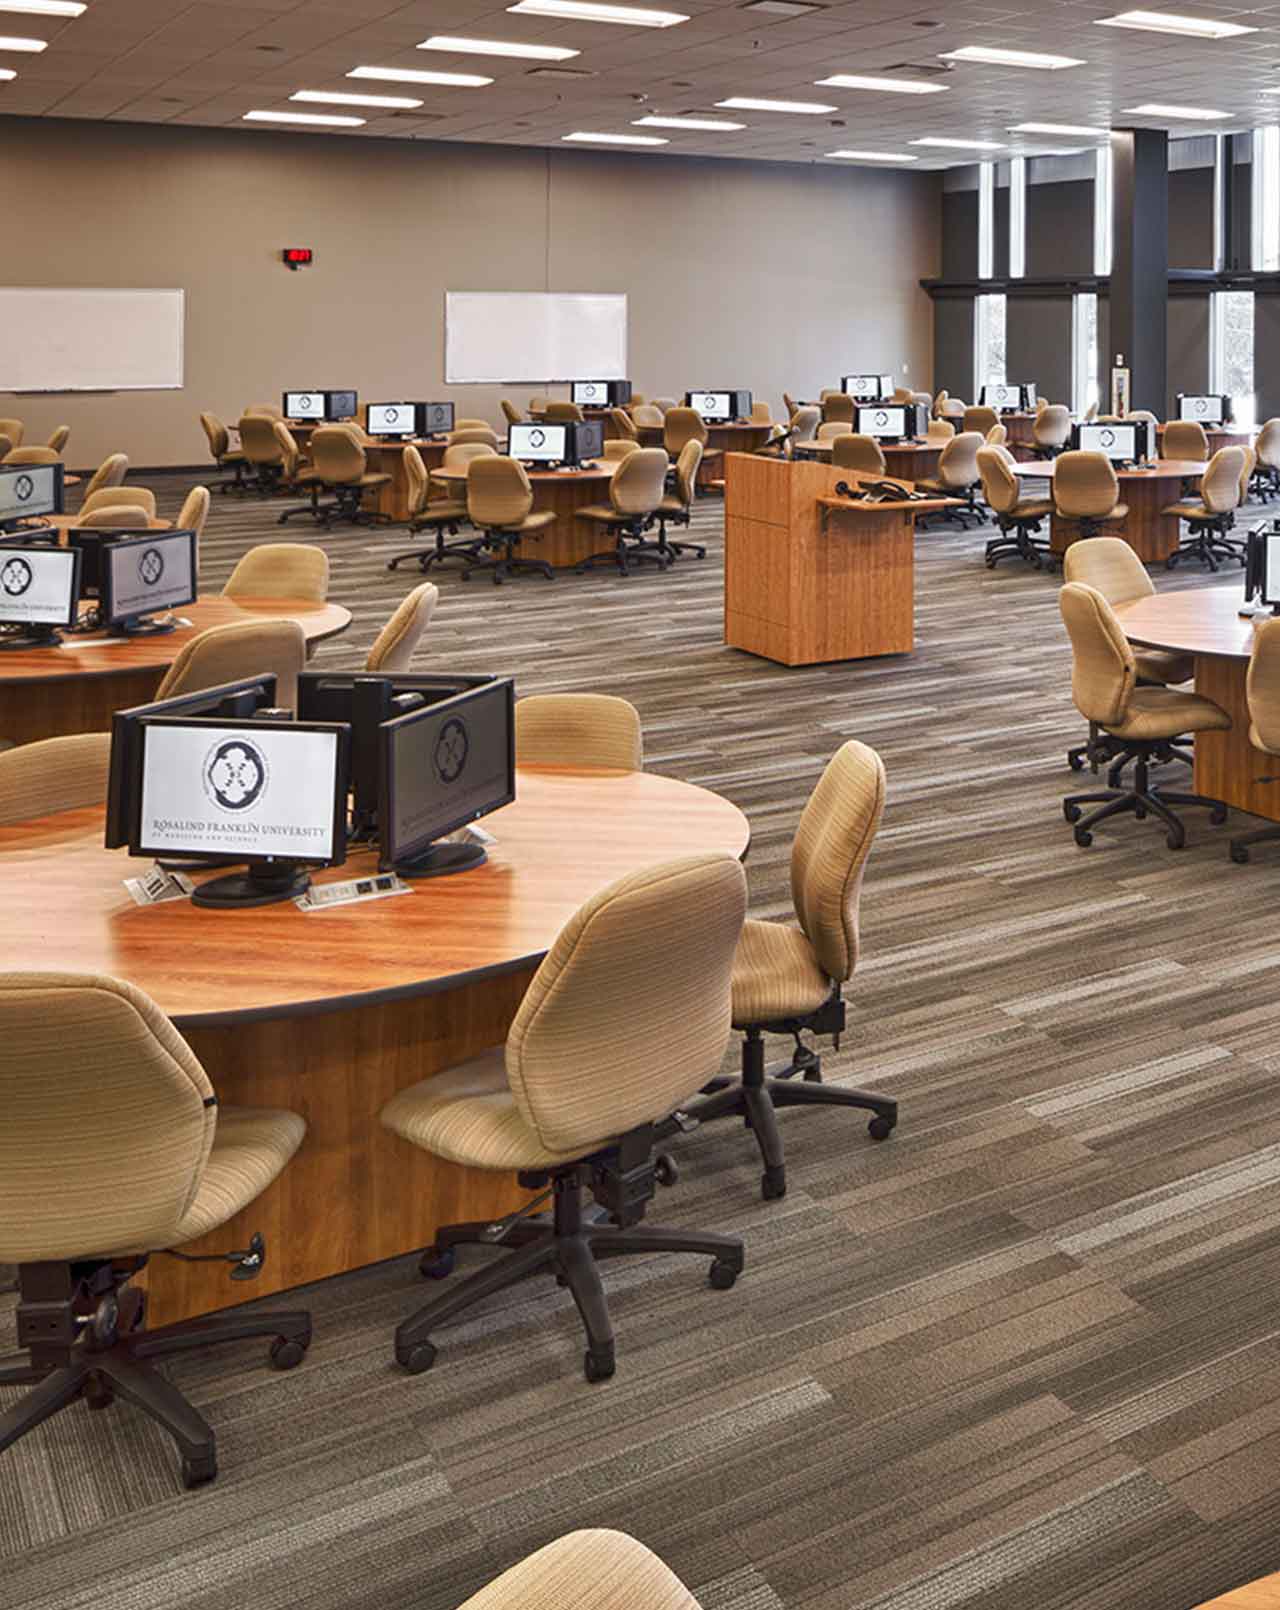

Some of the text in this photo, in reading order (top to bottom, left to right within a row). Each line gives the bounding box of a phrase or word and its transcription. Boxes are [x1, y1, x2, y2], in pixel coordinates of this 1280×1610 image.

[153, 819, 325, 838] ROSALIND FRANKLIN UNIVERSITY
